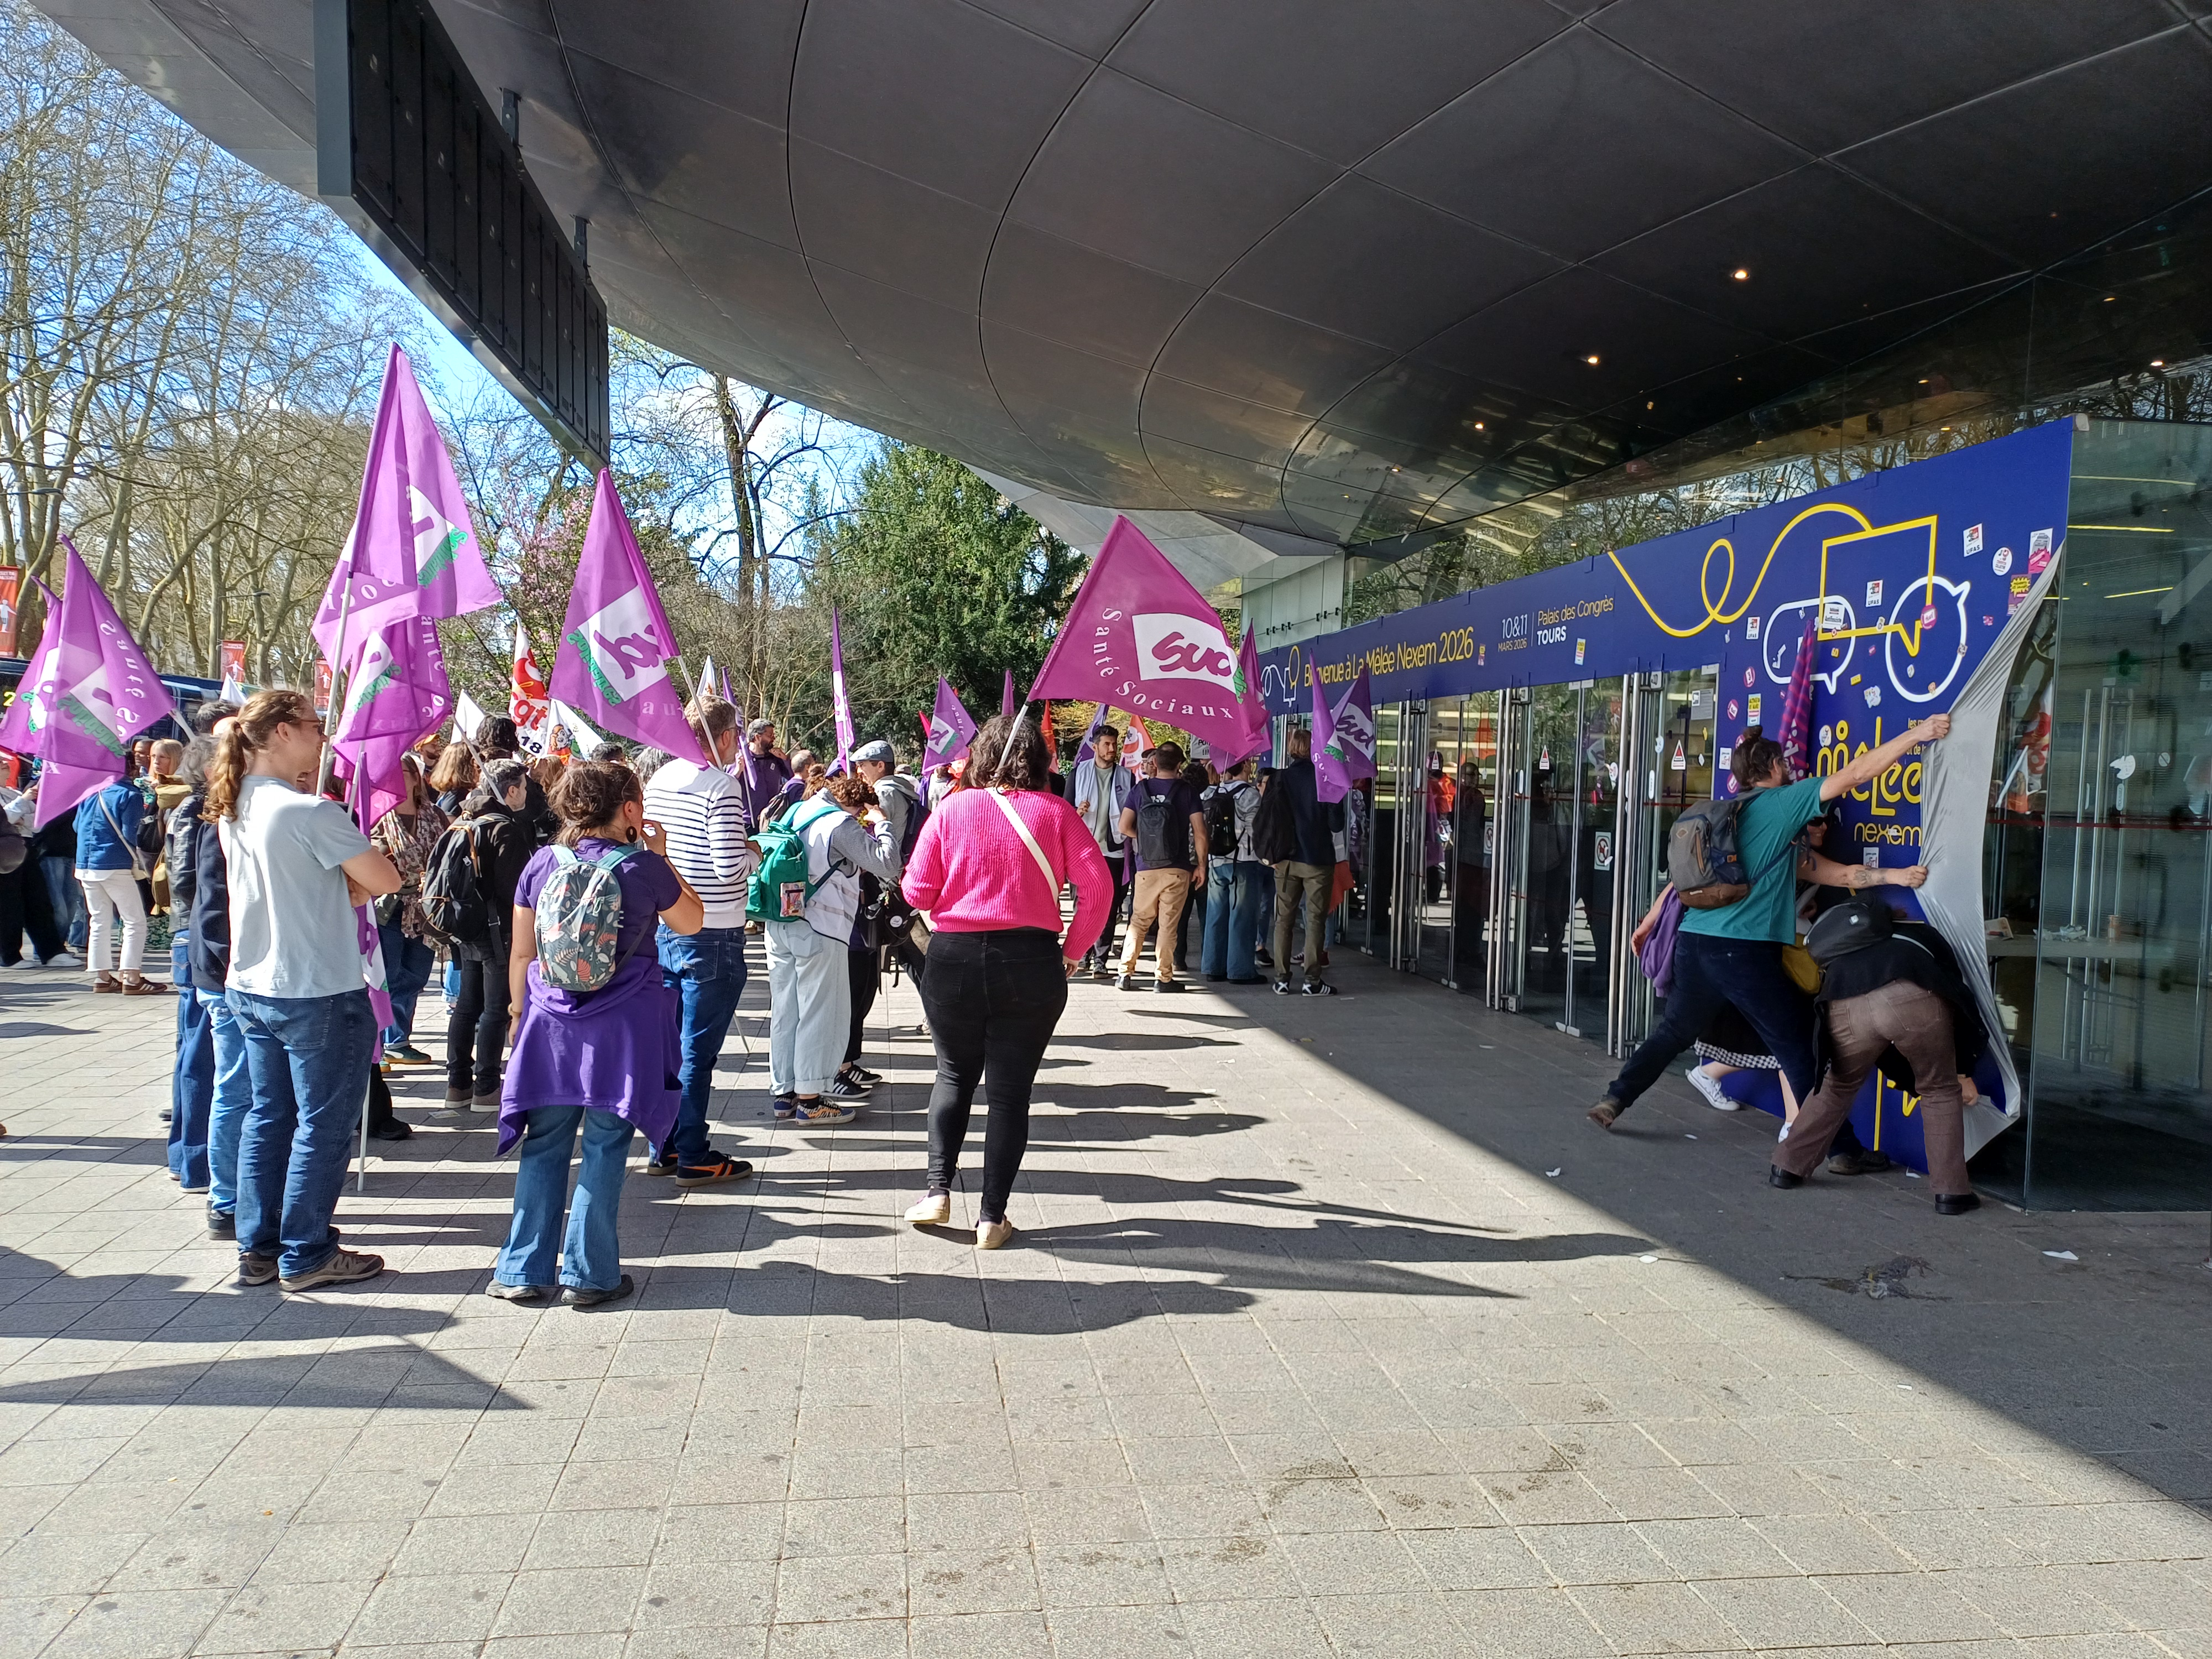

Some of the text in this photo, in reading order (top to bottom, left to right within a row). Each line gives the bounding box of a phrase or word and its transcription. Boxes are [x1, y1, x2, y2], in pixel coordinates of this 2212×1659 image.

[1966, 545, 1980, 554] UFAS
[1537, 594, 1614, 627] Palais des Congrès
[1502, 614, 1527, 639] 10&11
[1537, 625, 1567, 646] TOURS
[1093, 608, 1122, 677] Santé
[1498, 638, 1527, 652] MARS 2026
[1305, 626, 1474, 687] Binvenue à La Mêlée Nexem 2026
[1115, 681, 1234, 719] Sociaux
[521, 735, 542, 754] 18
[1854, 822, 1922, 847] nexem
